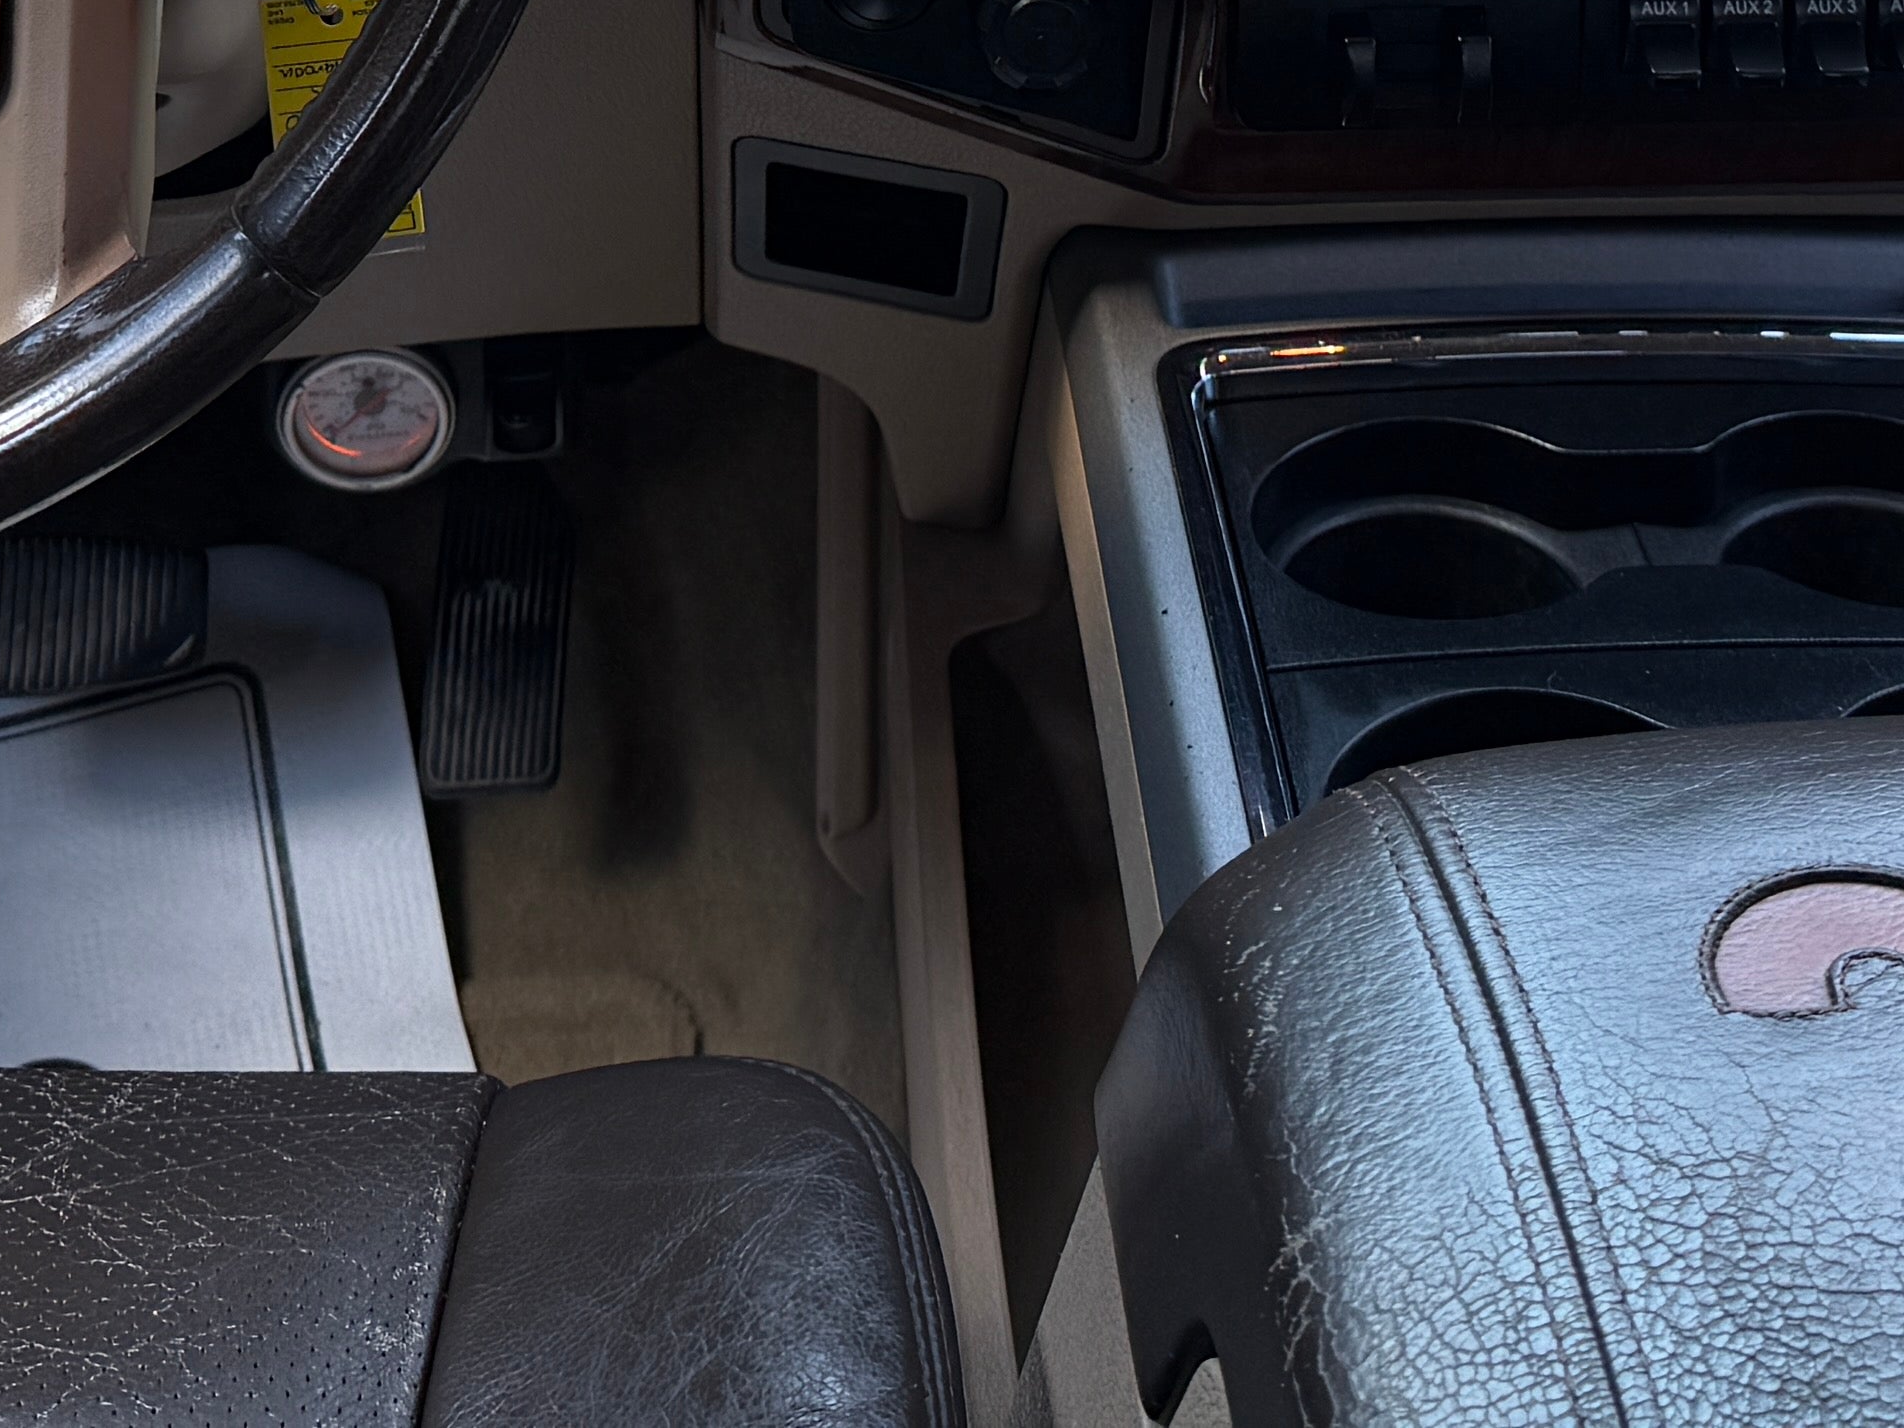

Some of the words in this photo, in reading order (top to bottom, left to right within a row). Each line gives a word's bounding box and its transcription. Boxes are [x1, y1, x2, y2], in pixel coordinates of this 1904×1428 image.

[1641, 1, 1677, 16] AUX
[1682, 1, 1689, 15] 1
[1723, 0, 1759, 15] AUX
[1763, 0, 1773, 15] 2
[1807, 0, 1844, 14] AUX
[1847, 0, 1857, 14] 3
